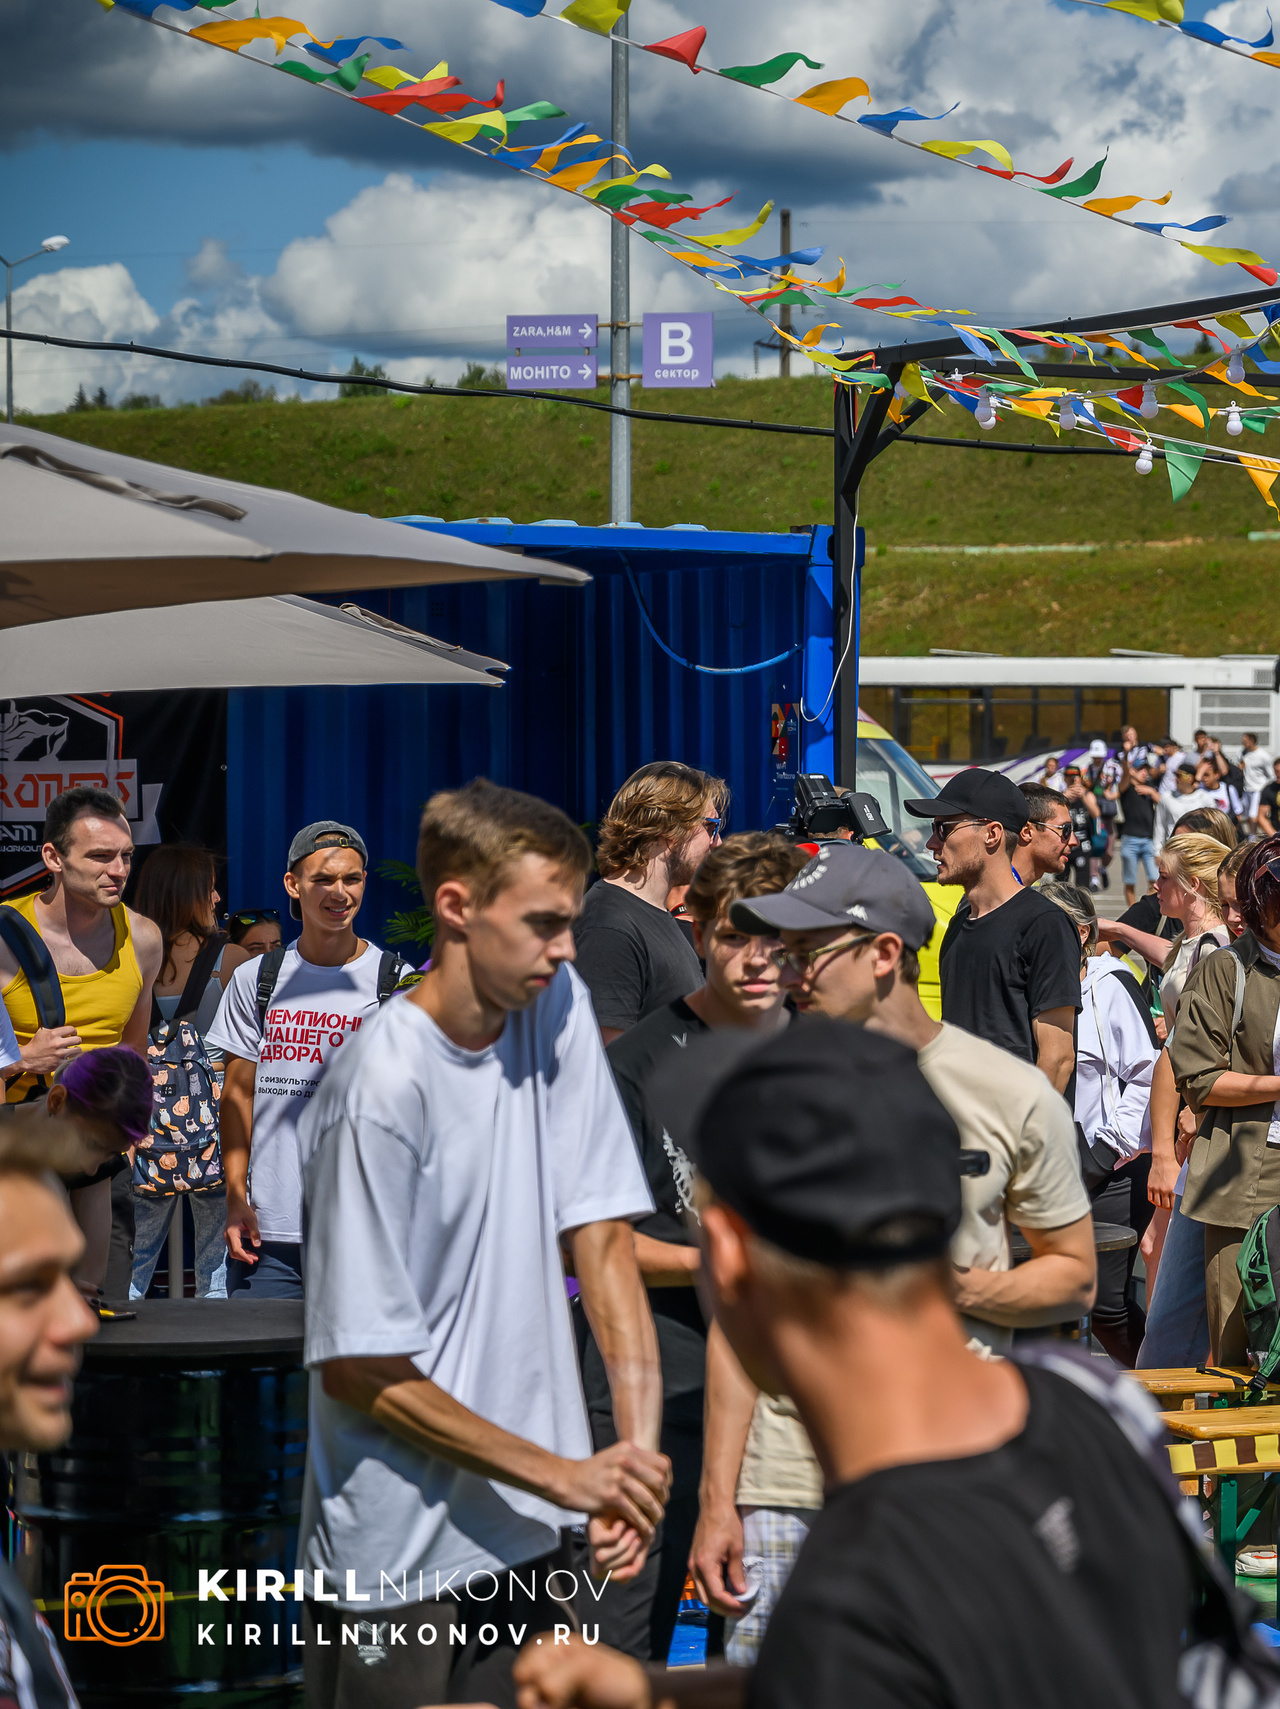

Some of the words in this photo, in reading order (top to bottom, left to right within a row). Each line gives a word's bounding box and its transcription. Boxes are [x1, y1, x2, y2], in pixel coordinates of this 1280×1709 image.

[512, 325, 572, 338] ZARA,H&M
[654, 368, 700, 381] сектор
[264, 1027, 344, 1048] НАШЕГО
[260, 1044, 323, 1064] ДВОРА
